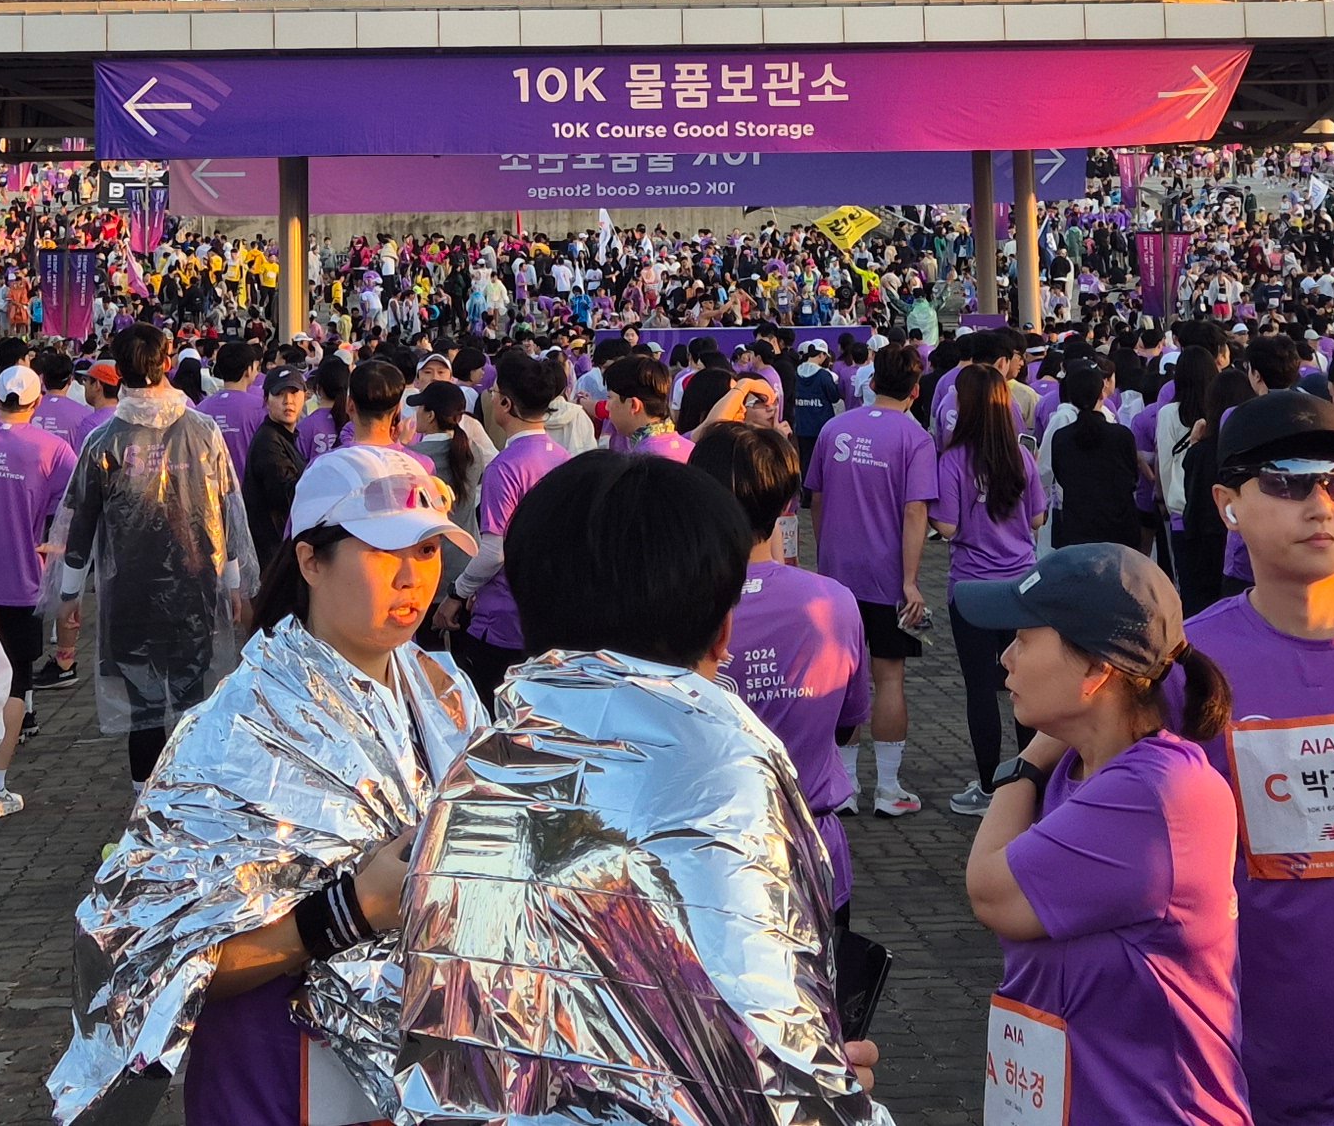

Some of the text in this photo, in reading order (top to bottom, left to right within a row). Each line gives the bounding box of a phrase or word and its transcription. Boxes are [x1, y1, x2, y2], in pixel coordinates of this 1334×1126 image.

[512, 62, 849, 110] 10K 물품보관소
[552, 120, 815, 140] 10K Course Good Storage
[744, 647, 776, 661] 2024
[745, 662, 778, 675] JTBC
[746, 675, 786, 689] SEOUL
[747, 687, 814, 703] MARATHON
[1264, 773, 1292, 802] C
[1004, 1023, 1024, 1047] AIA
